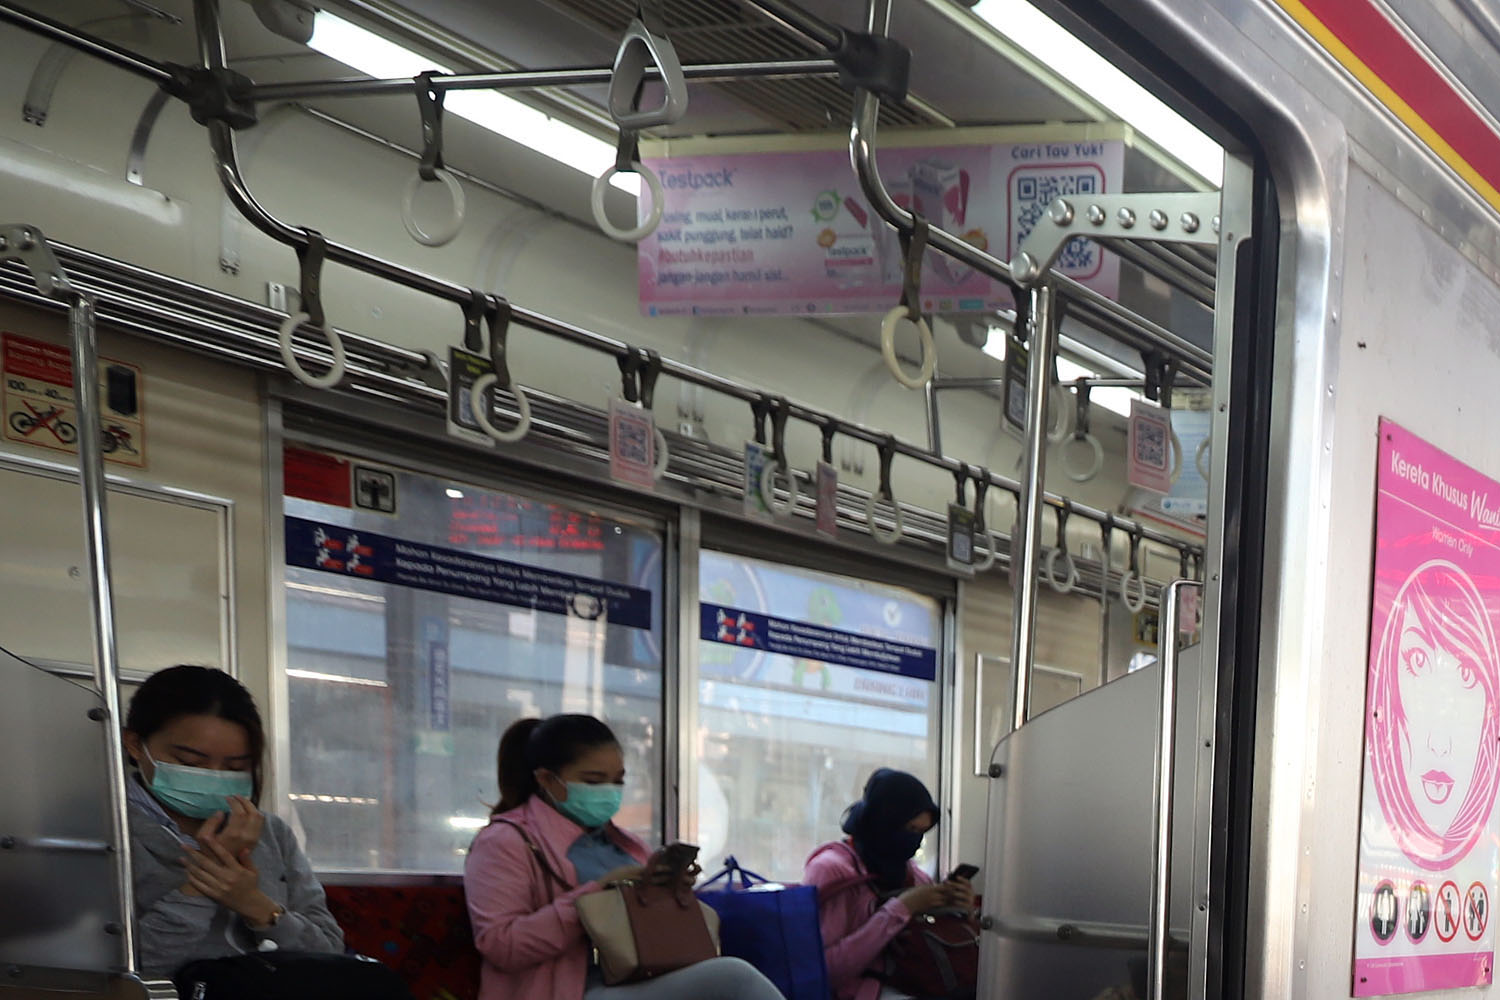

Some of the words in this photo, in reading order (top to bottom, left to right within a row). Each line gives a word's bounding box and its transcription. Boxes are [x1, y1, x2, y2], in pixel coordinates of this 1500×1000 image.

[1011, 146, 1041, 160] Cari
[1391, 450, 1430, 491] Kereta
[1432, 472, 1468, 511] Khusus
[1432, 525, 1458, 550] Women
[1458, 537, 1474, 558] Only
